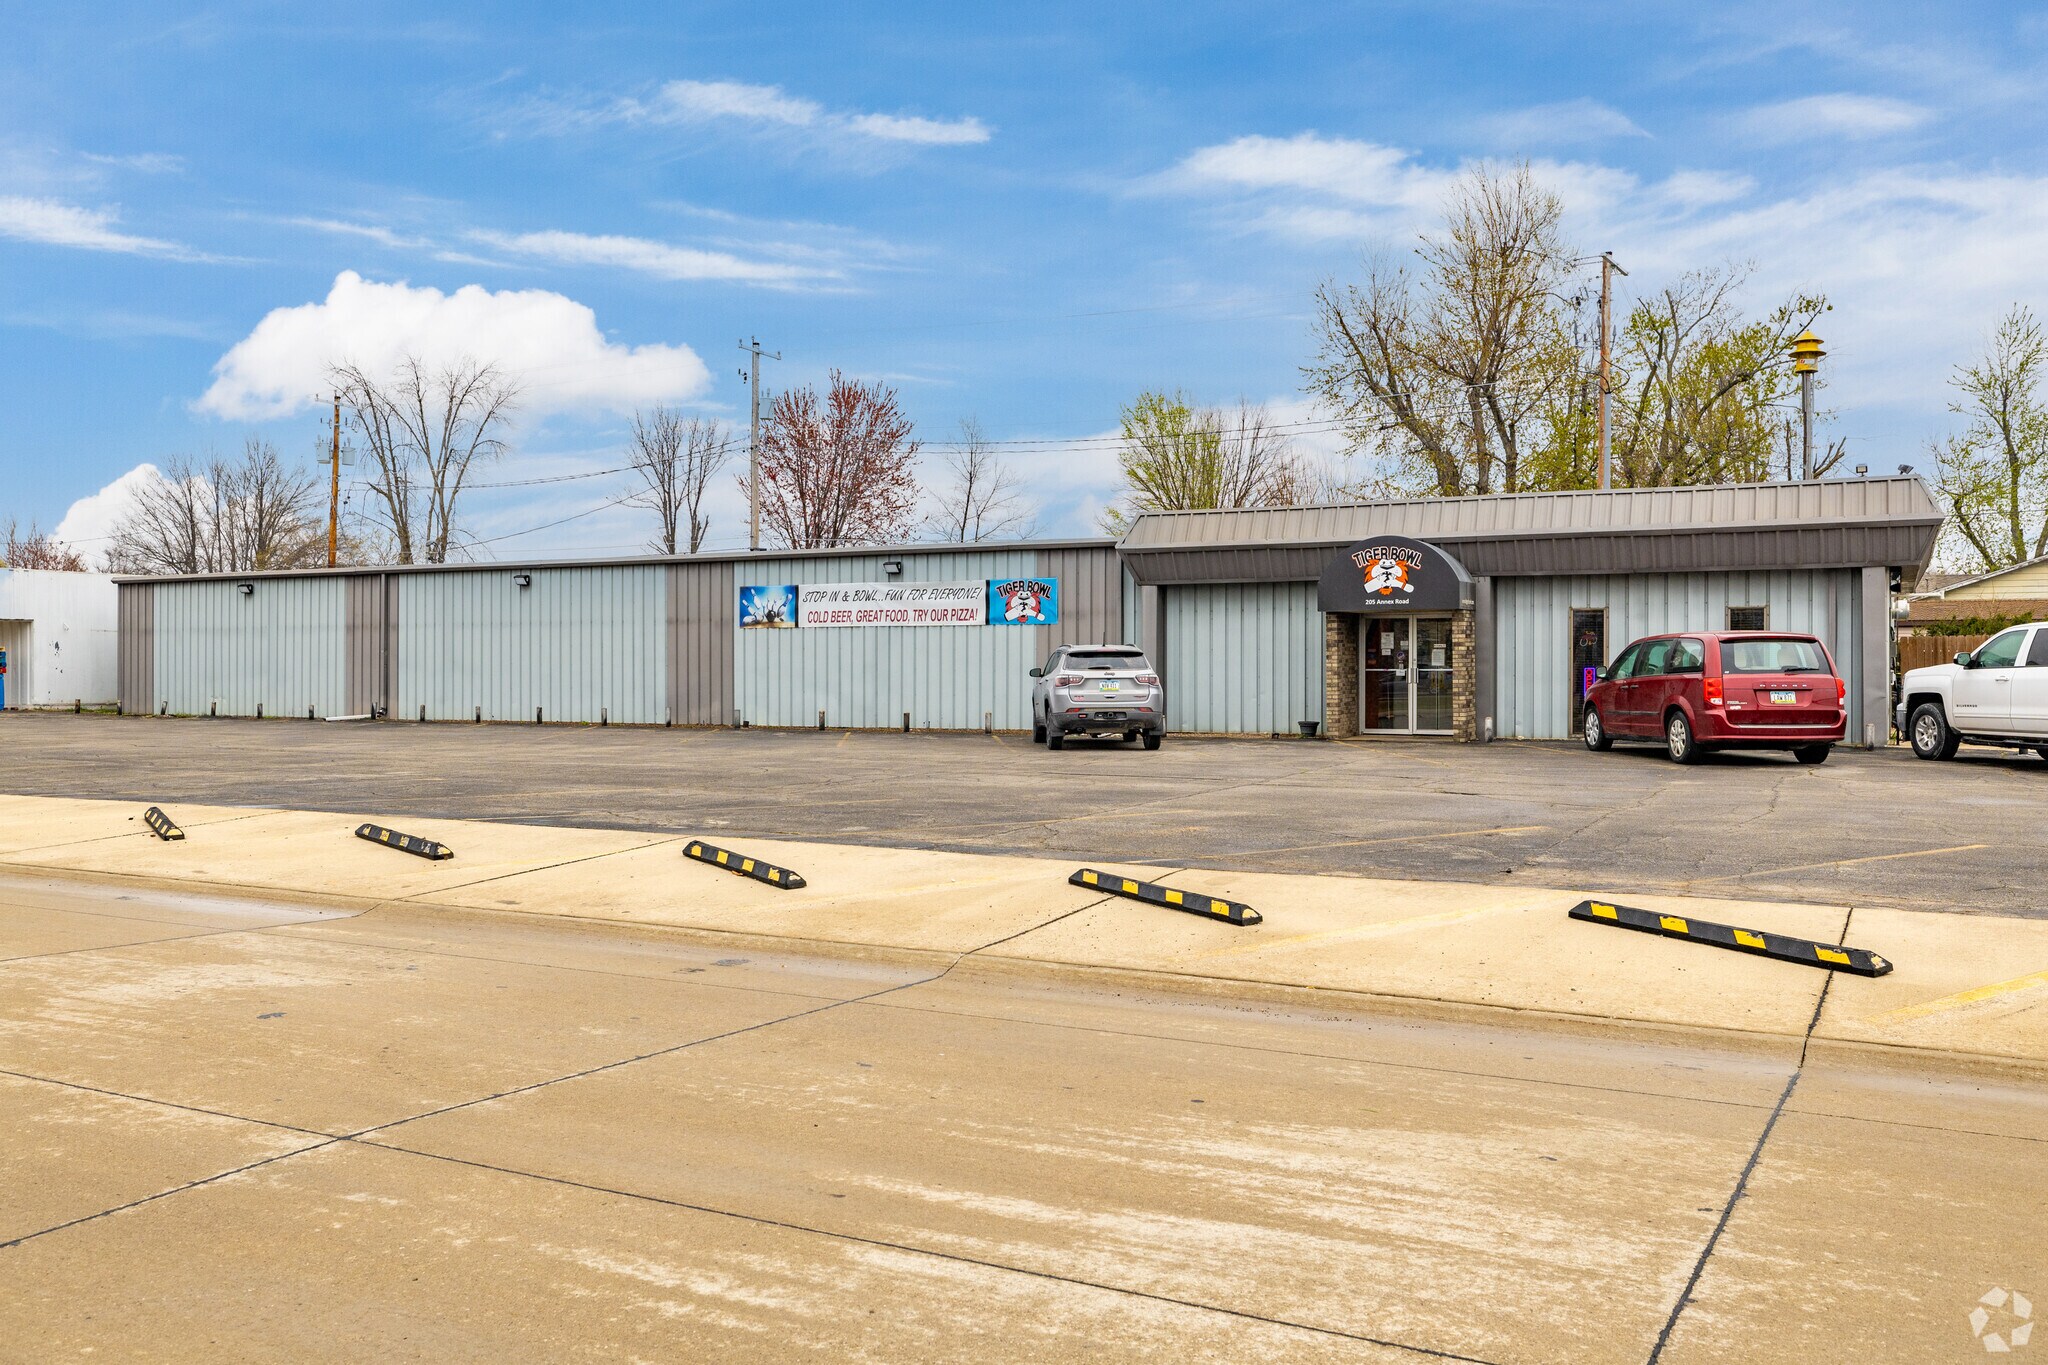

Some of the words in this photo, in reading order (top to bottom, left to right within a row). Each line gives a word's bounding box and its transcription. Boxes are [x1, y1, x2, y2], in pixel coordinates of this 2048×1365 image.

[1352, 546, 1388, 568] TIGER
[1390, 546, 1422, 569] BOWL
[802, 590, 827, 603] STOP
[828, 590, 840, 602] IN
[841, 591, 850, 602] &
[907, 588, 927, 601] FOR
[928, 587, 982, 600] EVERYONE!
[995, 580, 1025, 598] TIGER
[1027, 580, 1052, 600] BOWL
[807, 611, 829, 624] COLD
[830, 610, 854, 625] BEER,
[855, 609, 884, 623] GREAT
[885, 609, 910, 624] FOOD,
[913, 608, 929, 622] TRY
[930, 608, 949, 622] OUR
[950, 608, 979, 621] PIZZA!
